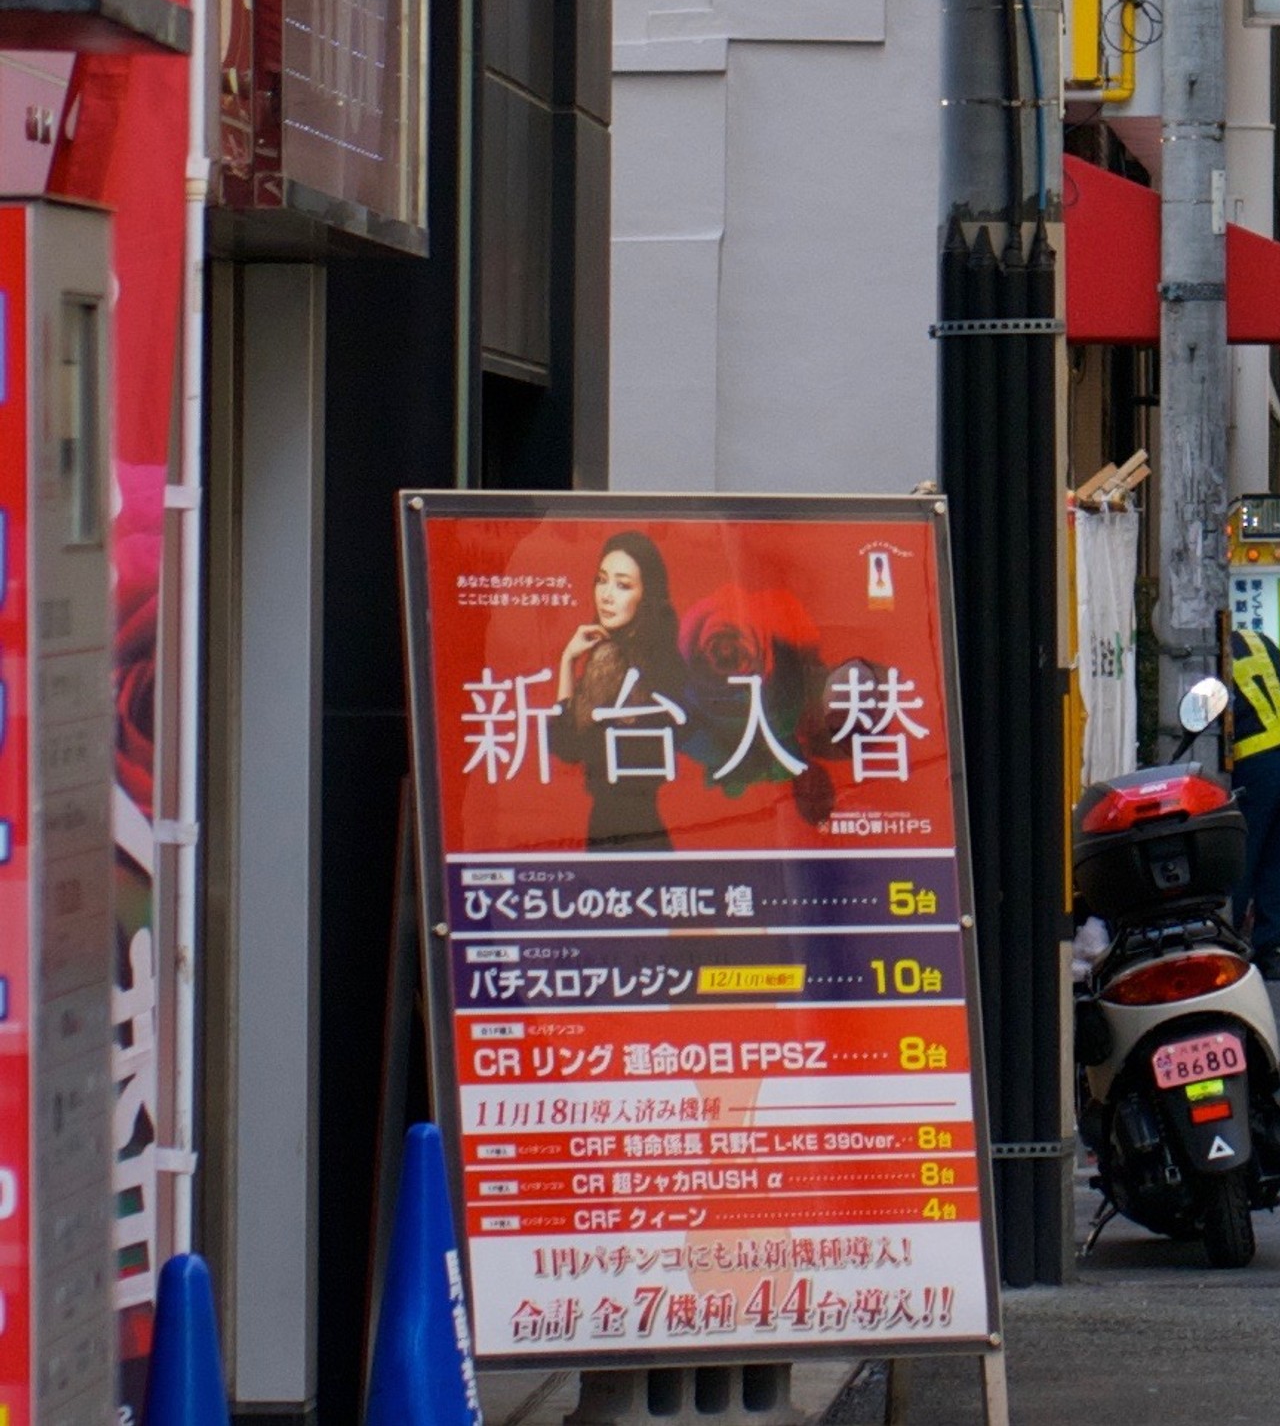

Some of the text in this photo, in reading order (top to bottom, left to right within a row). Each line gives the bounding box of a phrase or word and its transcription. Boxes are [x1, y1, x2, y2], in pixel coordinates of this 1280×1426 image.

[460, 666, 931, 784] 新台入替
[463, 884, 755, 922] ひぐらしのなく頃に 煌
[889, 881, 938, 917] 5台
[469, 963, 694, 1000] パチスロアレジン
[870, 959, 943, 996] 10台
[473, 1040, 827, 1077] CR リング 運命の日 FPSZ
[898, 1036, 948, 1071] 8台
[1177, 1046, 1238, 1079] 8680
[475, 1096, 722, 1129] 11月18日導入済み機種
[570, 1133, 617, 1158] CRF
[623, 1131, 704, 1158] 特命係長
[710, 1130, 770, 1155] 只野仁
[917, 1125, 953, 1150] 8台
[571, 1171, 605, 1196] CR
[612, 1167, 759, 1195] 超シャカRUSH
[920, 1161, 955, 1187] 8台
[573, 1207, 622, 1231] CRF
[921, 1197, 957, 1221] 4台
[510, 1298, 582, 1342] 合計
